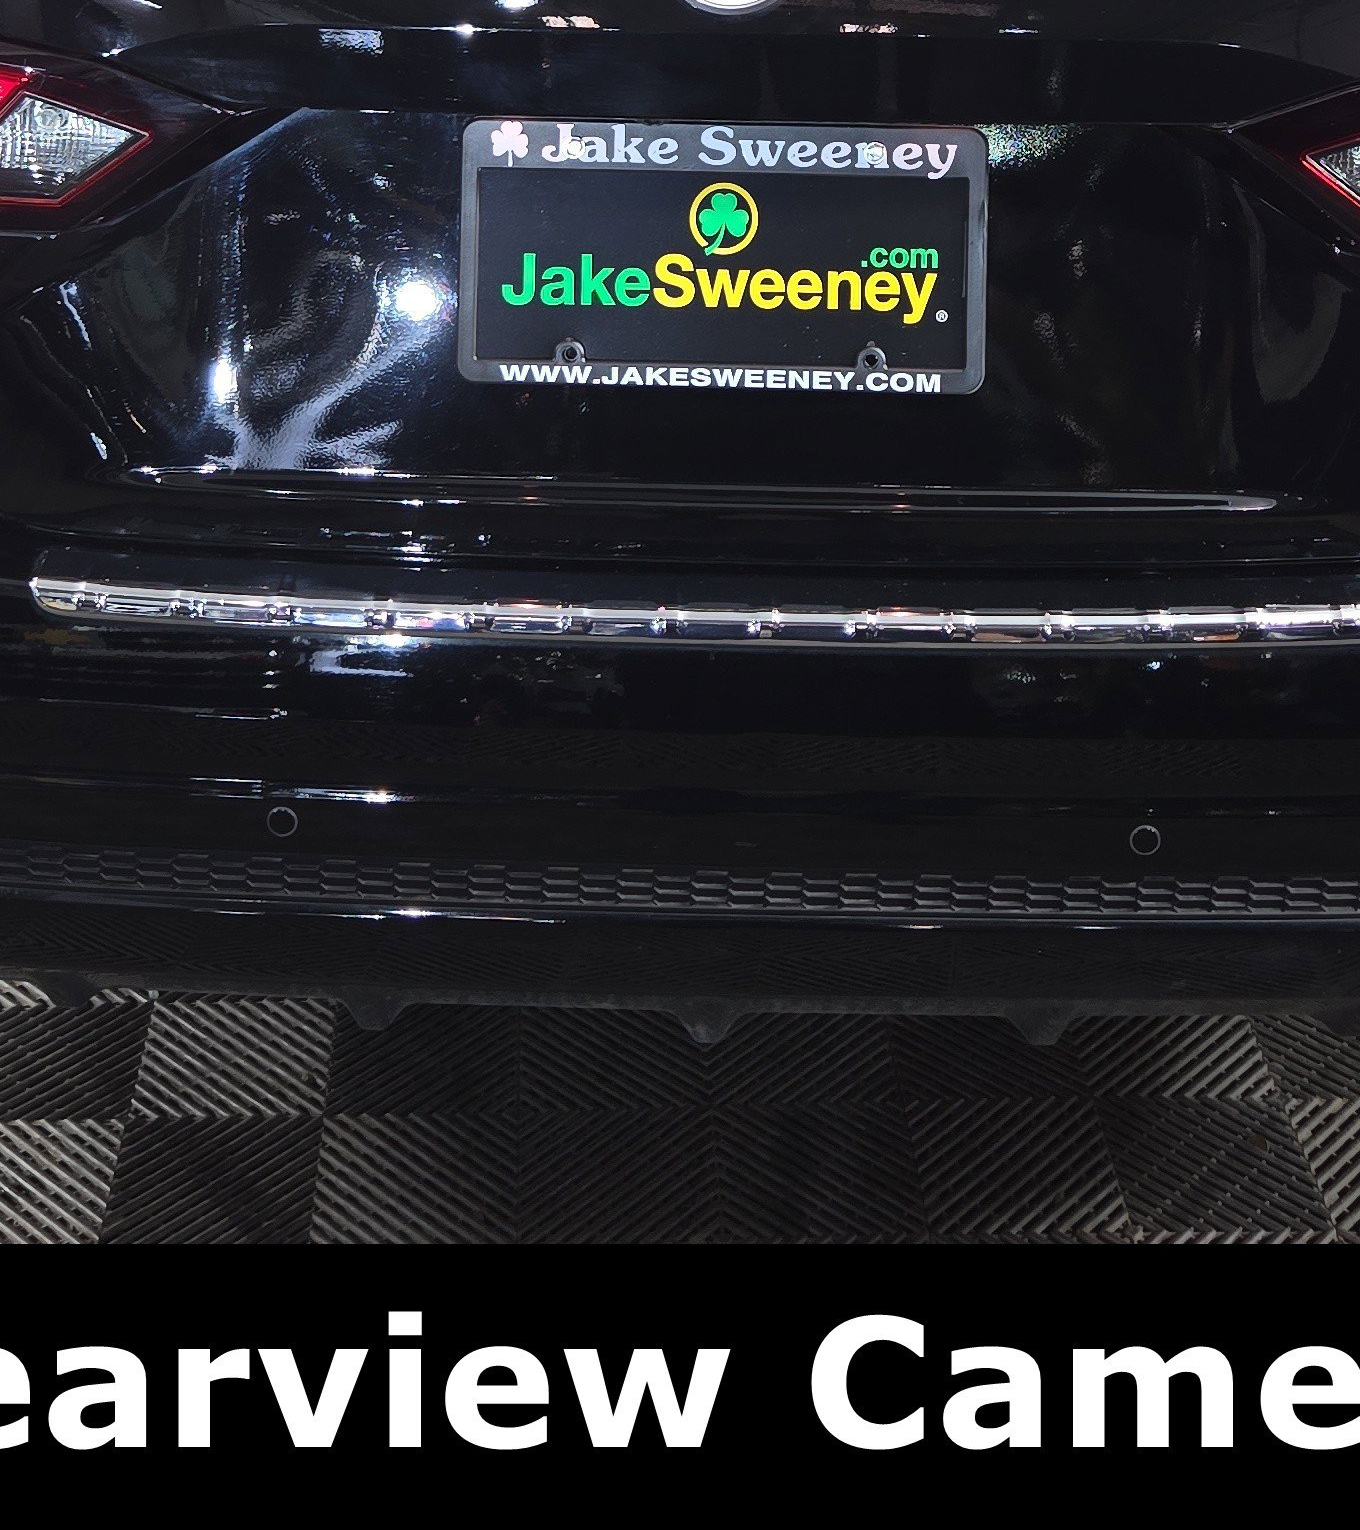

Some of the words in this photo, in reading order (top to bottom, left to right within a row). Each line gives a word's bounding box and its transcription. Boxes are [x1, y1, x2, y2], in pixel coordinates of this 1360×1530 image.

[542, 124, 679, 163] Jake
[700, 126, 958, 179] Sweeney
[500, 365, 942, 394] WWW.JAKESWEENEY.COM
